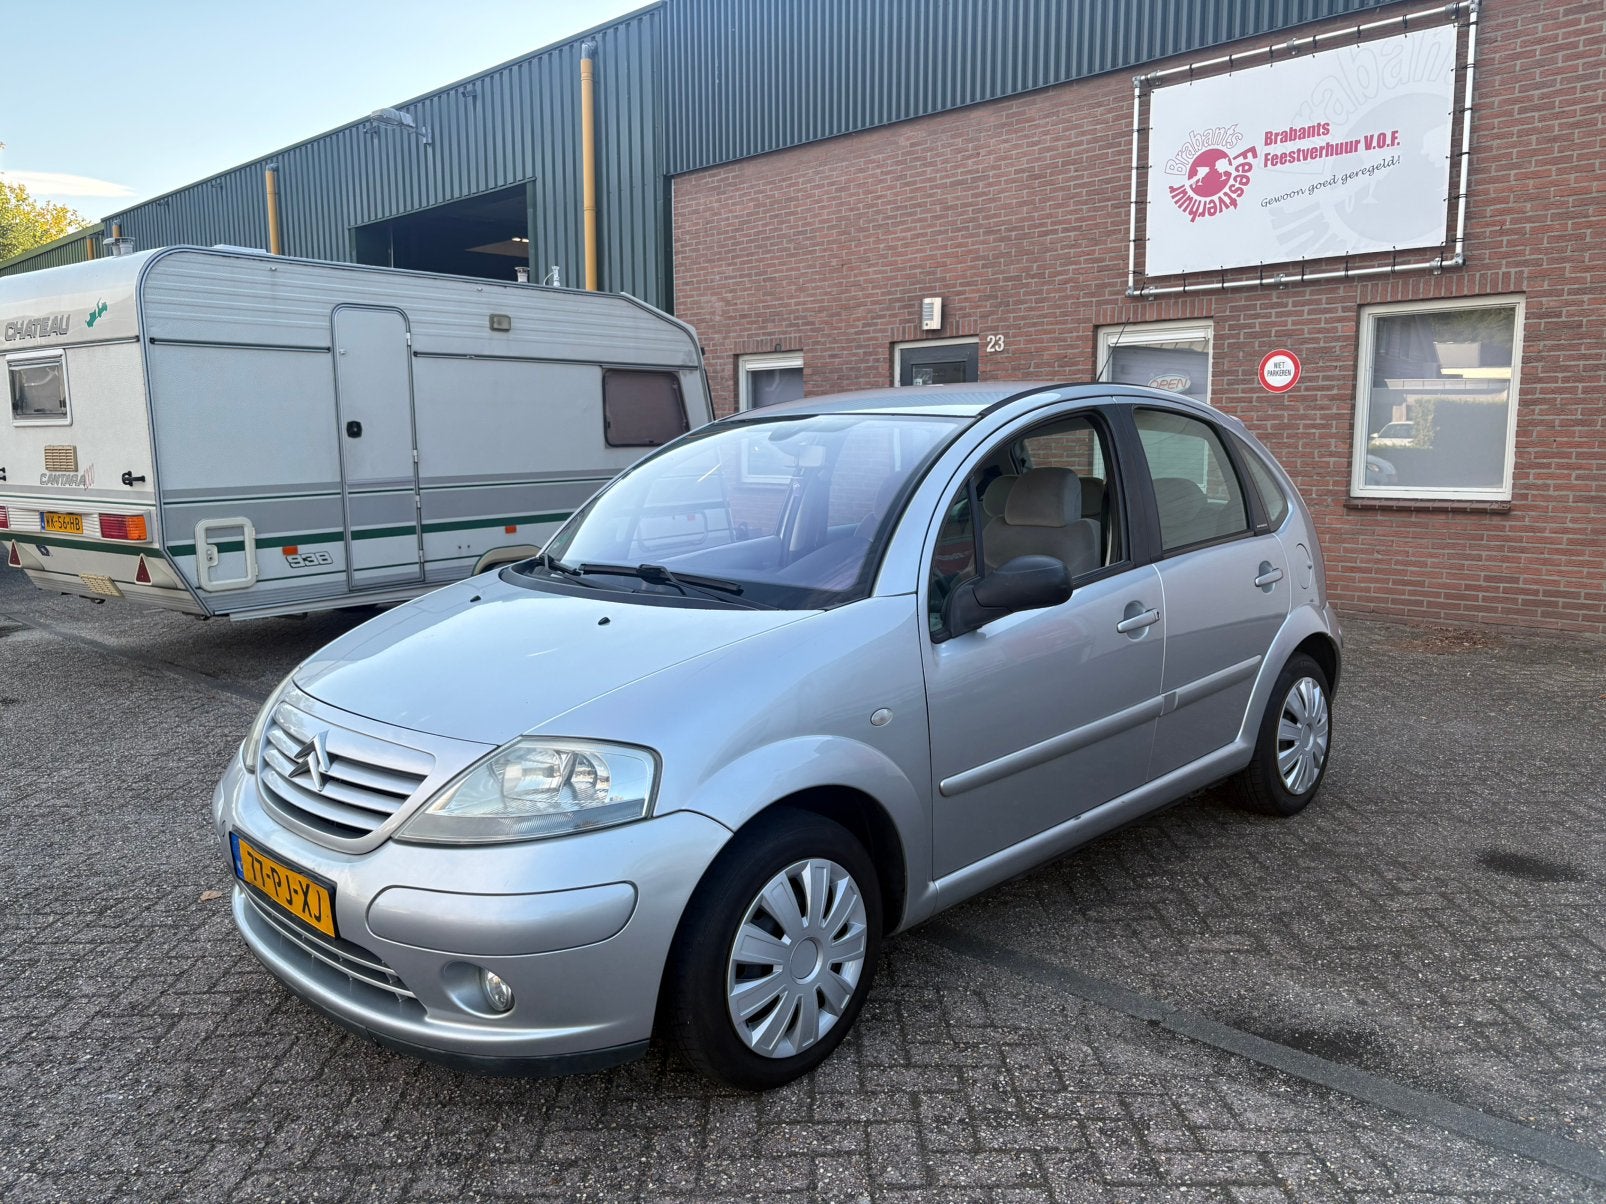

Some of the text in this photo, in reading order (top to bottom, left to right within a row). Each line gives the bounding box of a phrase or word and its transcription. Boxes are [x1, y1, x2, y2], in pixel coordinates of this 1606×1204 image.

[1264, 122, 1330, 146] Brabants
[1164, 123, 1244, 176] Brabants
[1263, 130, 1401, 168] Feestverhuur V.O.F.
[1168, 145, 1258, 223] Feestverhuur
[1260, 155, 1401, 208] Gewoon goed geregeld!
[5, 314, 71, 342] CHATEAU
[986, 334, 1005, 352] 23
[1267, 369, 1291, 377] PARKEREN
[1273, 361, 1286, 369] NIET
[1150, 378, 1188, 390] OPEN
[45, 514, 81, 531] WK-56-HB
[285, 551, 333, 569] 938
[246, 850, 323, 924] 77-PJ-XJ
